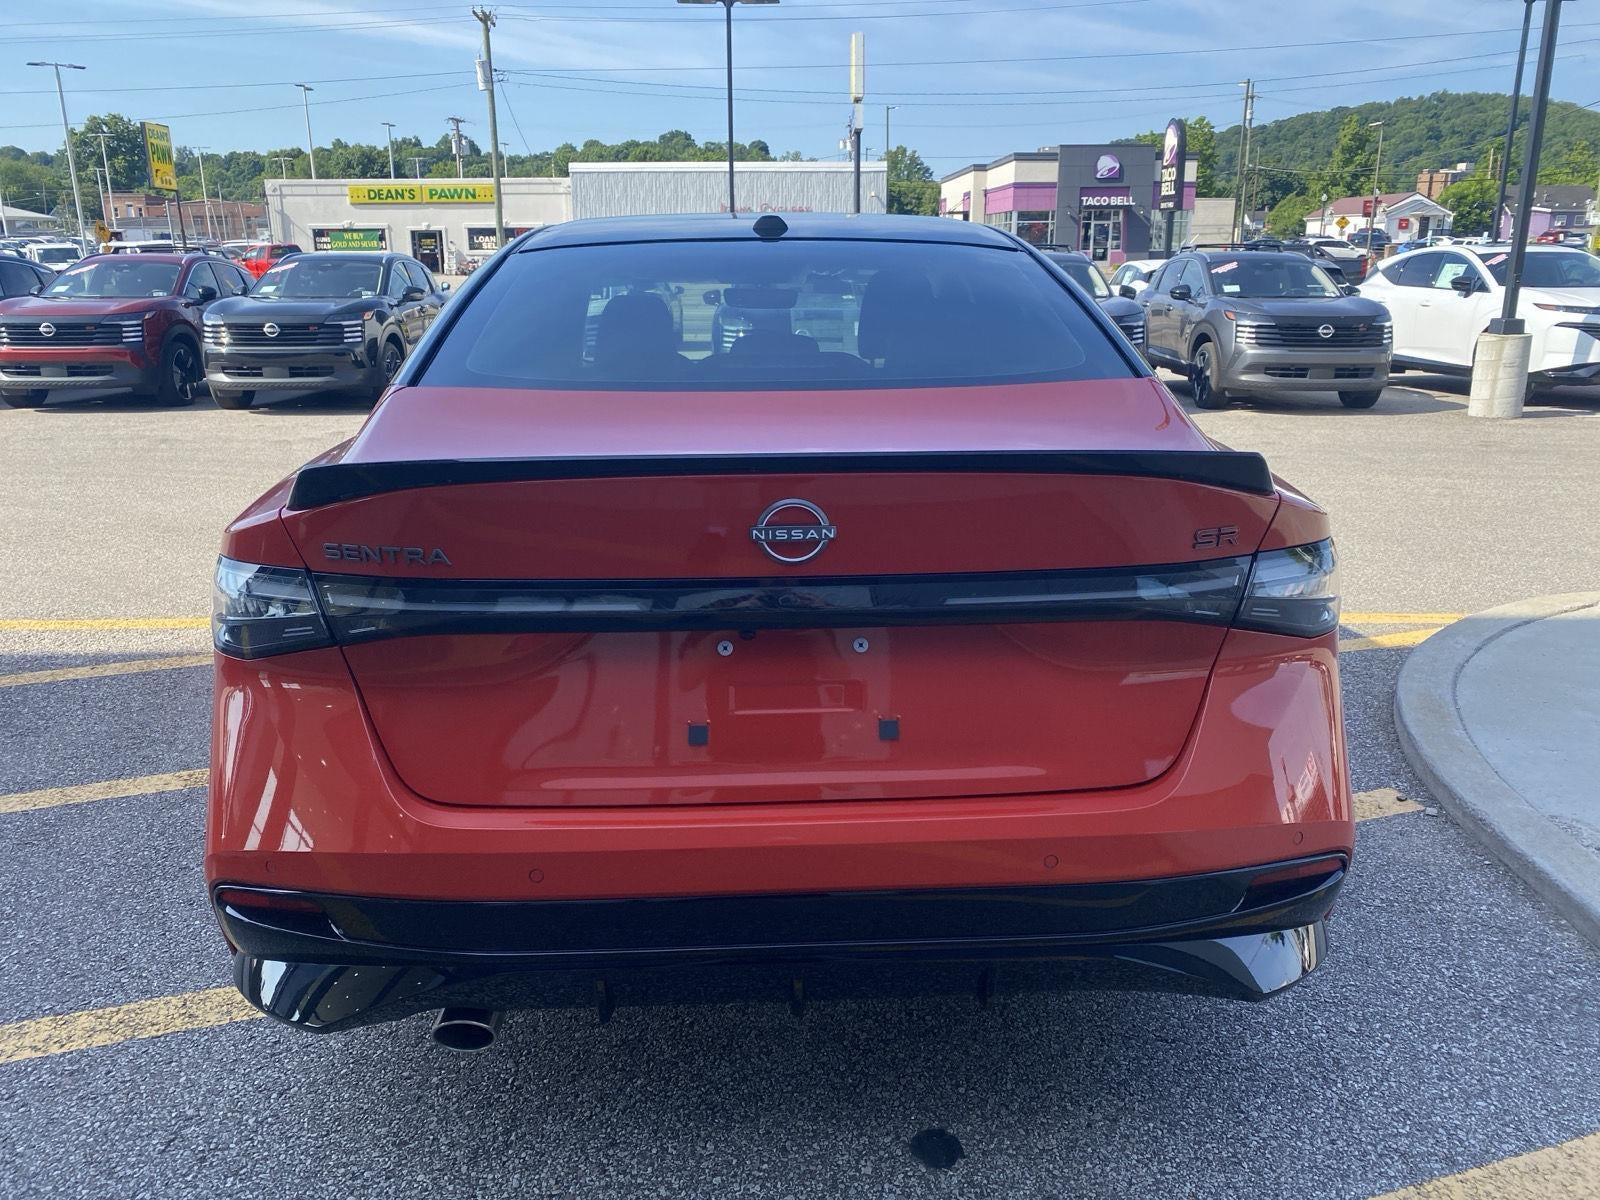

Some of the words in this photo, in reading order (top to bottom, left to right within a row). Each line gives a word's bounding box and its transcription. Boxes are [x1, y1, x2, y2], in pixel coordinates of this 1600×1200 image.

[150, 142, 172, 165] PAWN
[1161, 167, 1176, 182] TACO
[367, 188, 416, 201] DEAN'S
[428, 188, 477, 200] PAWN
[1161, 181, 1175, 195] BELL
[1081, 197, 1109, 206] TACO
[1110, 197, 1136, 205] BELL
[331, 240, 347, 249] GOLD
[347, 240, 360, 249] AND
[360, 240, 378, 248] SILVER
[751, 528, 836, 540] NISSAN
[1192, 526, 1240, 550] SR
[322, 542, 453, 567] SENTRA
